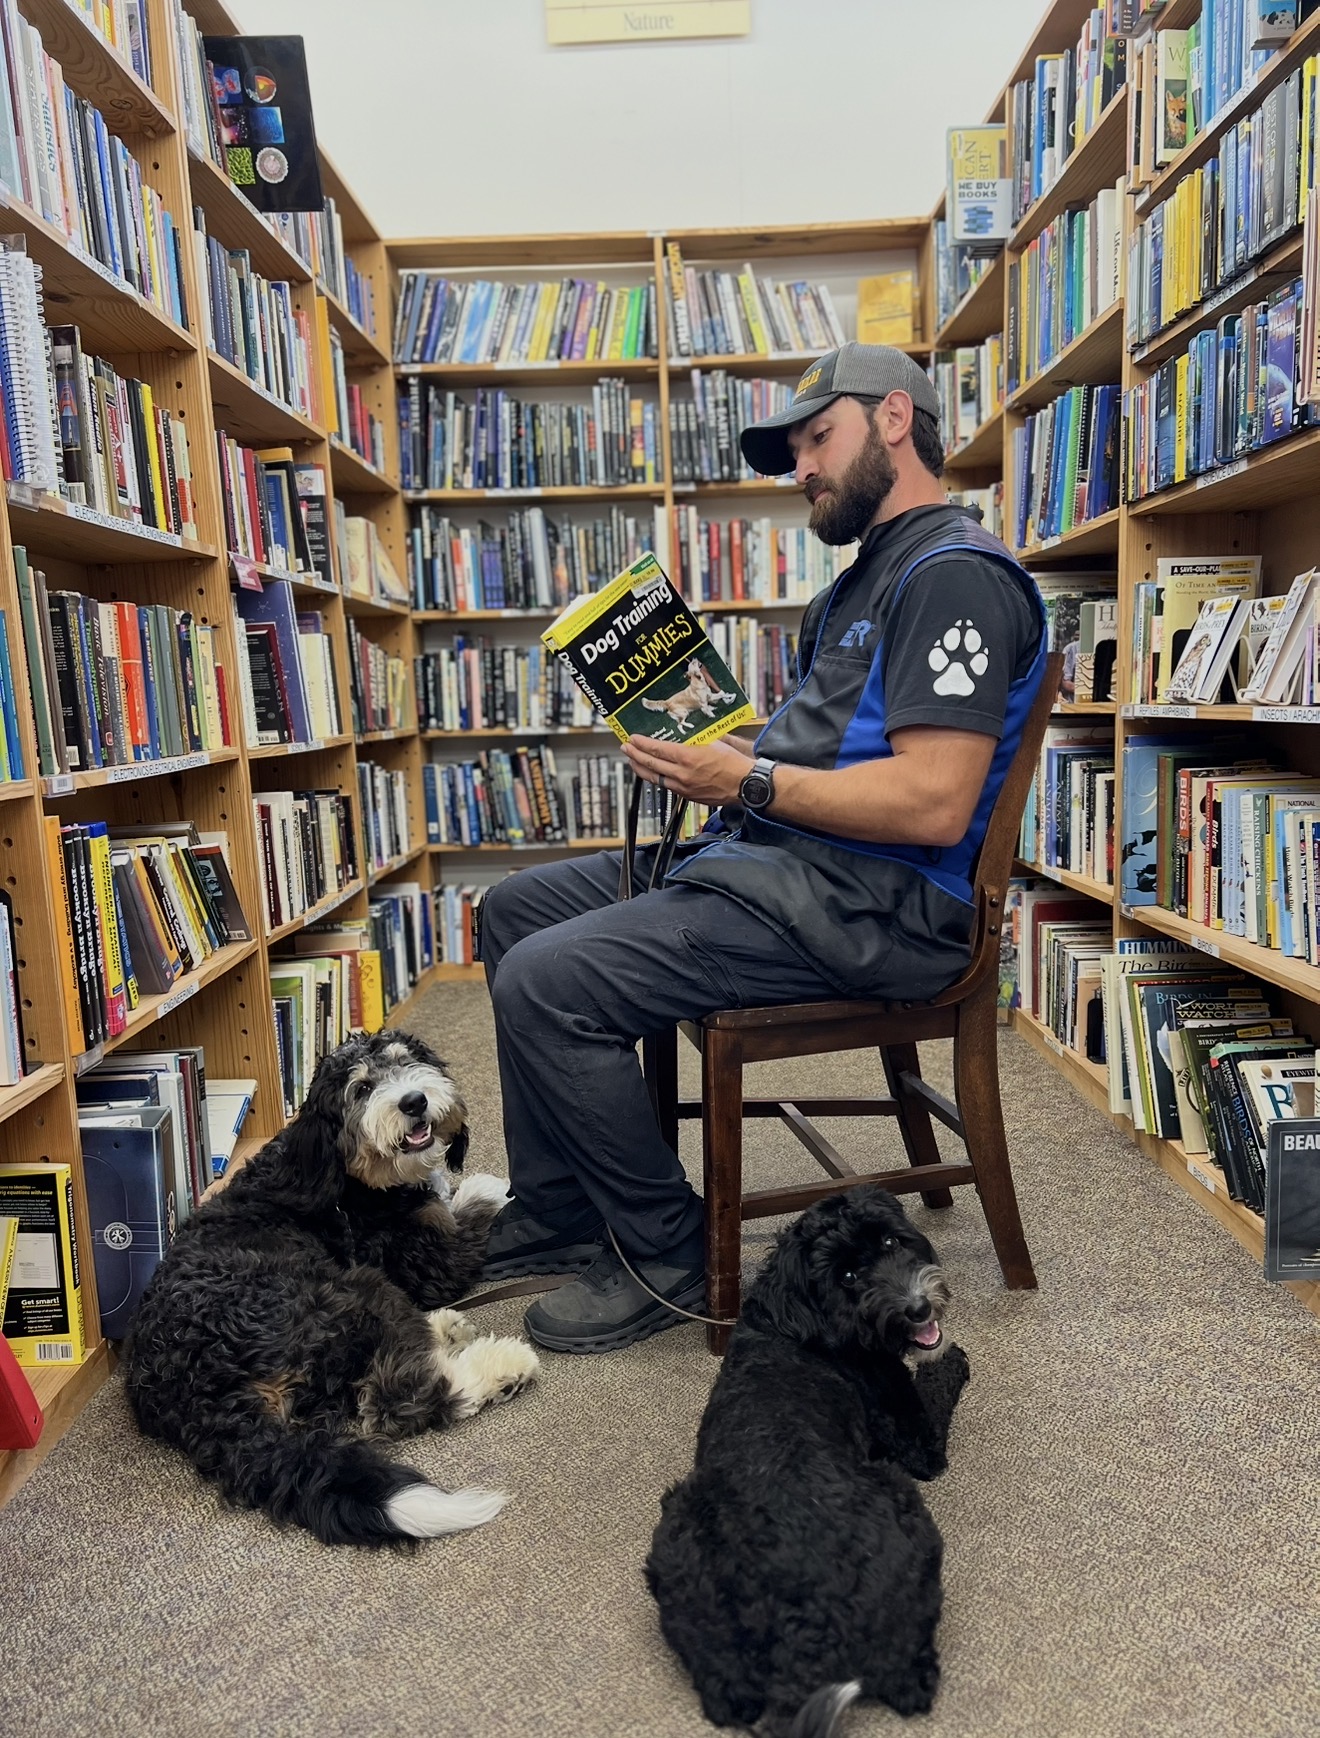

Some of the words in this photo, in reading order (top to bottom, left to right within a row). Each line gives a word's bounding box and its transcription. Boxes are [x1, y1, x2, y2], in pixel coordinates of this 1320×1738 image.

[624, 12, 674, 31] Nature
[27, 66, 46, 173] STATISTICS
[41, 95, 55, 173] Statistics
[958, 190, 997, 198] BOOKS
[959, 182, 972, 190] WE
[976, 181, 997, 189] BUY
[674, 300, 688, 344] EARTH
[717, 407, 730, 450] EARTH
[1020, 449, 1028, 519] MICROBIOLOGY
[1203, 466, 1225, 487] SCIENCE
[580, 631, 620, 665] Dog
[613, 583, 673, 636] Training
[635, 633, 648, 645] FOR
[1251, 623, 1267, 633] BIRDS
[85, 620, 101, 721] Thermodynamics
[93, 616, 101, 651] Basic
[98, 656, 110, 717] Television
[605, 614, 693, 695] DUMMIES
[269, 651, 284, 713] EDISON
[558, 652, 577, 676] Dog
[576, 674, 609, 716] Training
[696, 735, 707, 743] for
[707, 728, 717, 738] the
[717, 719, 731, 732] Rest
[1261, 709, 1288, 721] INSECTS
[530, 758, 551, 825] ASTRONOMY
[1179, 777, 1188, 830] BIRDS
[64, 903, 72, 936] building
[71, 866, 84, 933] Brooklyn
[78, 935, 88, 983] Bridge
[80, 864, 91, 930] Brooklyn
[86, 930, 96, 977] Bridge
[101, 861, 112, 924] REFERENCE
[110, 926, 118, 970] MANUAL
[163, 887, 176, 920] Control
[95, 932, 104, 974] Bridge
[120, 918, 131, 968] STATICS
[1197, 939, 1213, 954] BIRDS
[1118, 959, 1152, 973] The
[163, 985, 194, 1013] ENGINEERING
[1222, 1060, 1238, 1096] REFERENCE
[1232, 1096, 1252, 1140] BIRDS
[1247, 1137, 1253, 1146] OF
[1252, 1147, 1262, 1171] NORTH
[1193, 1167, 1208, 1187] BIRDS
[66, 1185, 76, 1242] Trigonometry
[21, 1298, 35, 1306] Get
[36, 1296, 60, 1305] smart!
